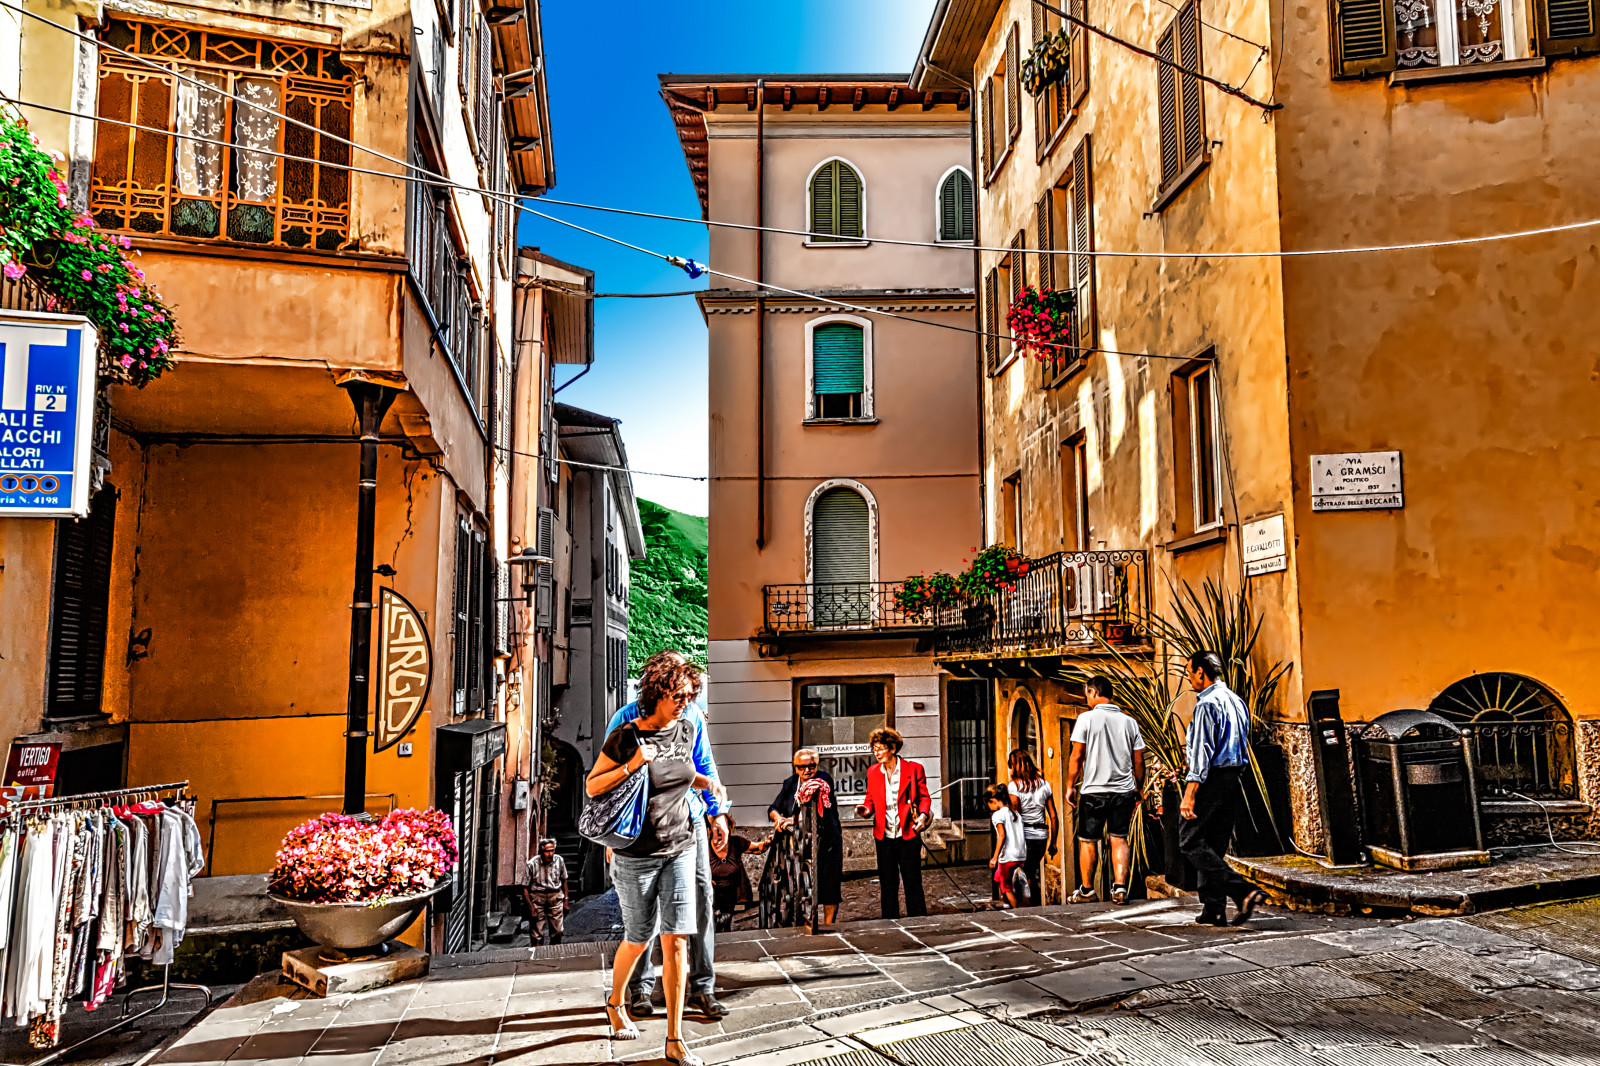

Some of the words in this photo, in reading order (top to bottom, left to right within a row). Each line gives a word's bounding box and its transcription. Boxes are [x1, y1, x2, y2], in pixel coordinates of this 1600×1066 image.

[35, 384, 54, 393] RIV.
[45, 395, 57, 410] 2
[33, 413, 44, 427] E
[0, 447, 40, 457] LORI
[1340, 466, 1386, 476] GRAMSCI
[33, 496, 58, 504] 4198
[20, 746, 51, 767] VERTIGO
[17, 768, 38, 777] outlet
